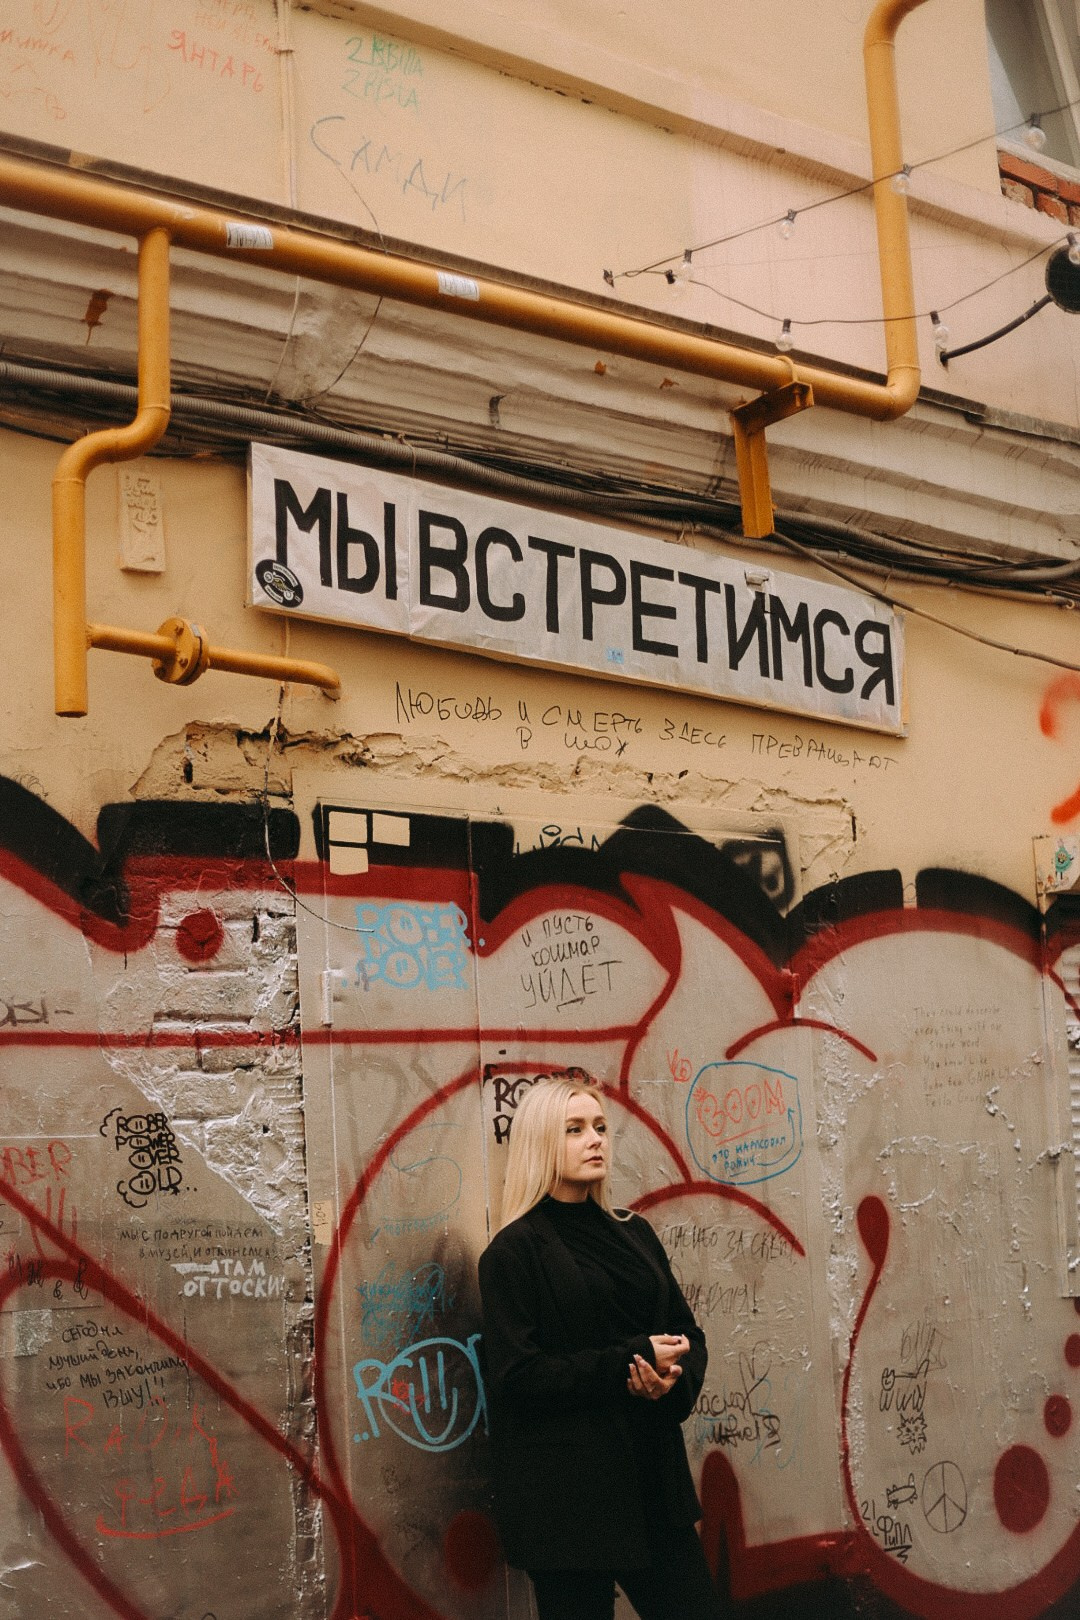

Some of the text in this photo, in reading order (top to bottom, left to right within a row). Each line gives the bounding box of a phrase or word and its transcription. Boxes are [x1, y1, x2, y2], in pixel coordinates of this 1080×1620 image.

[167, 28, 265, 94] ЯНТАРЬ
[274, 478, 896, 706] МЫ ВСТРЕТИМСЯ
[516, 726, 532, 750] В
[541, 705, 643, 733] СМЕРТЬ
[659, 718, 727, 748] ЗДЕСЬ
[542, 914, 594, 939] ПУСТЬ
